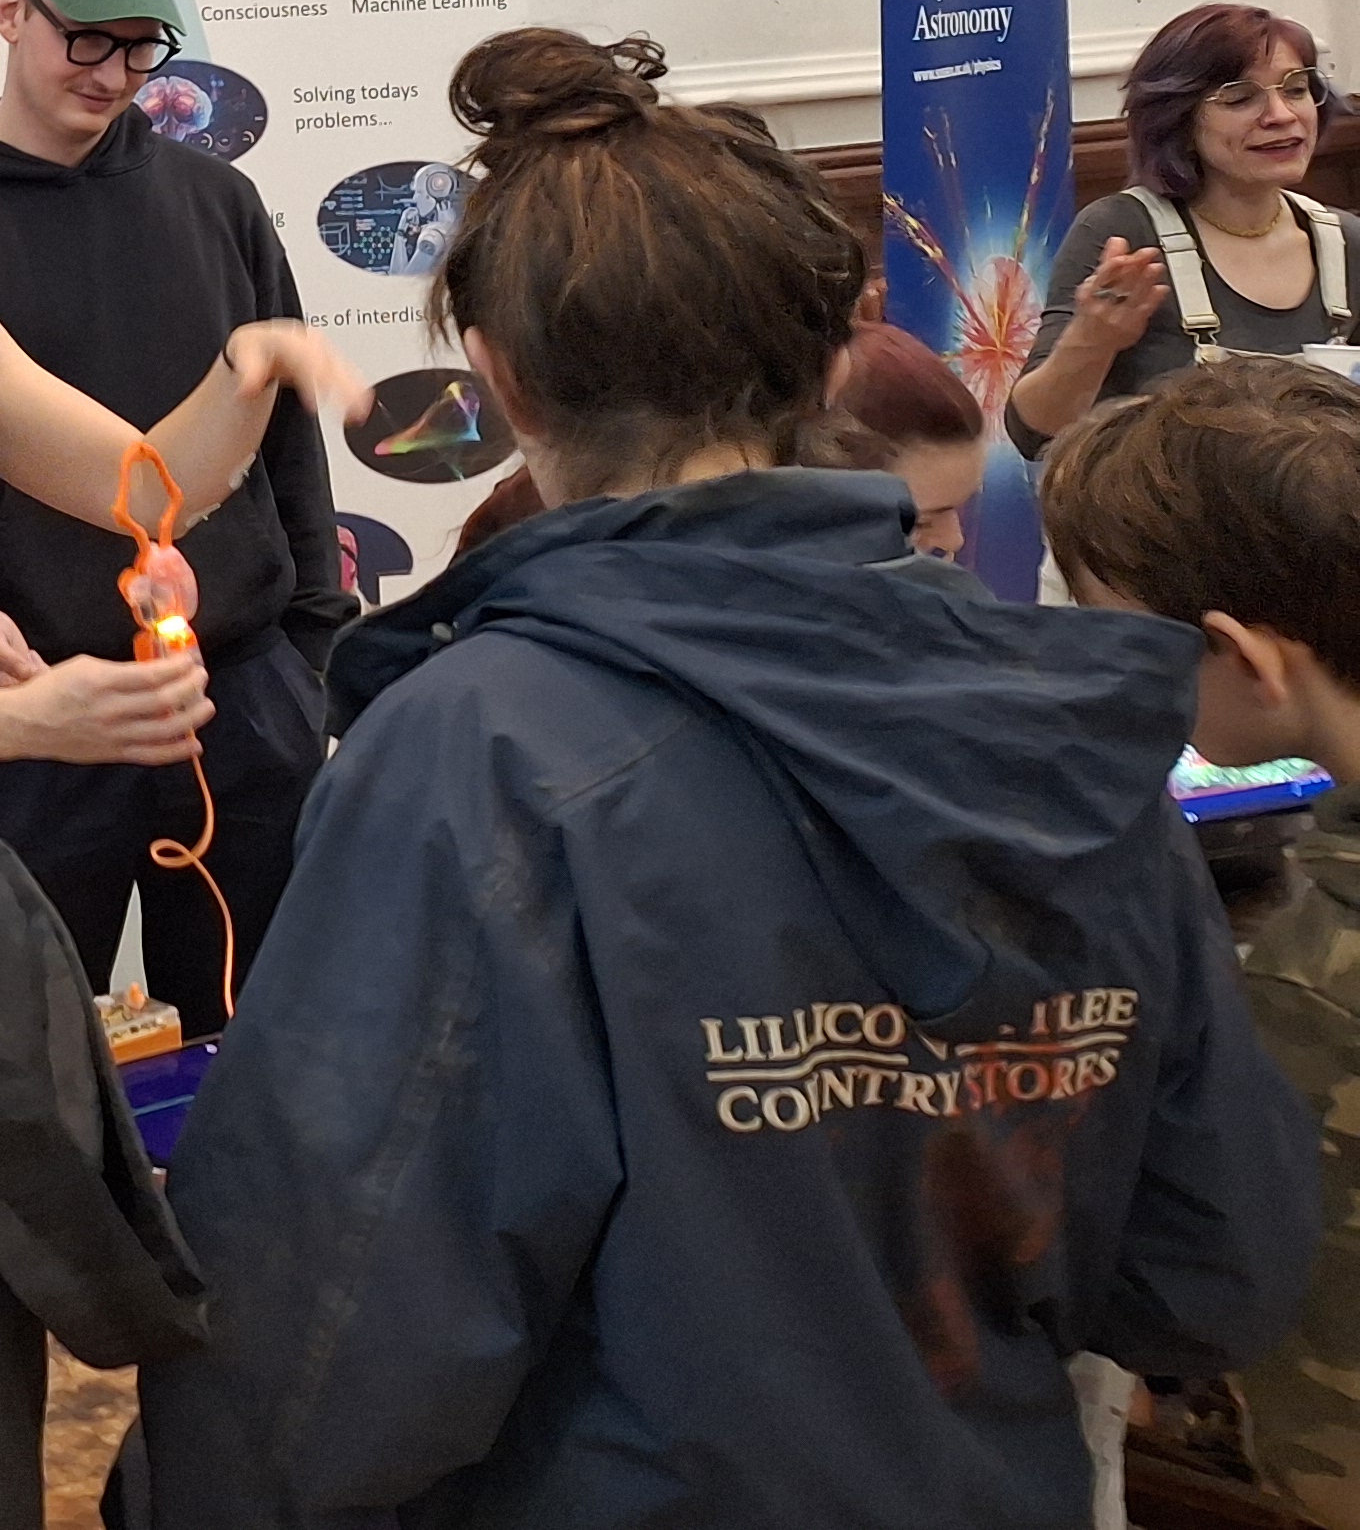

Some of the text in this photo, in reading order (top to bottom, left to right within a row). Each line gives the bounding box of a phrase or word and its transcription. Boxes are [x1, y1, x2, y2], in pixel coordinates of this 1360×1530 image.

[201, 2, 329, 22] Consciousness
[912, 4, 1014, 43] Astronomy
[293, 82, 419, 105] Solving todays
[333, 308, 352, 326] of
[356, 306, 425, 325] interdis
